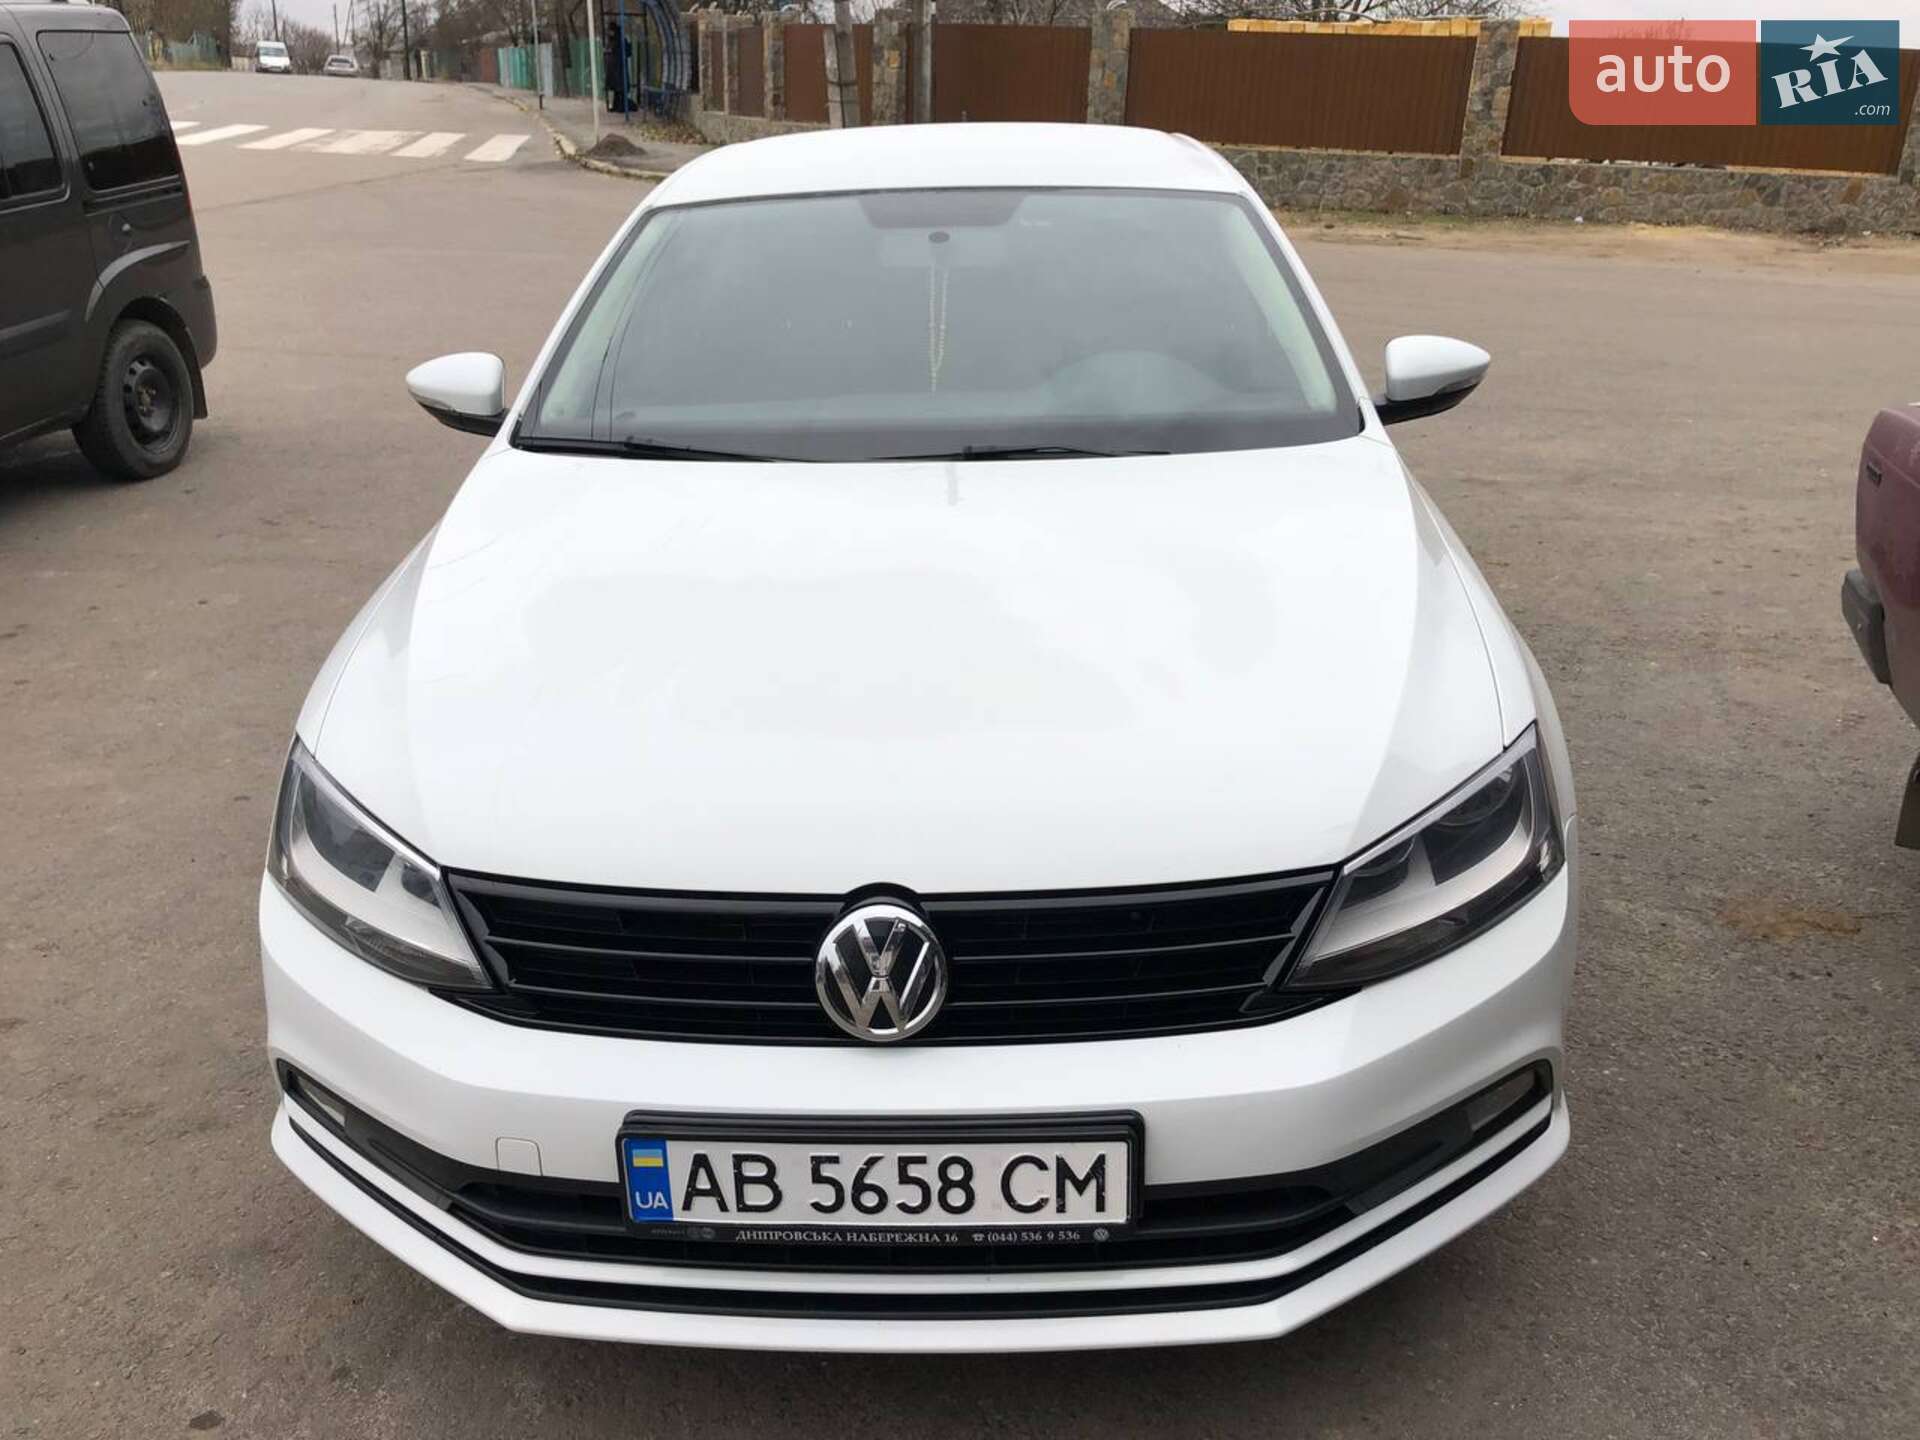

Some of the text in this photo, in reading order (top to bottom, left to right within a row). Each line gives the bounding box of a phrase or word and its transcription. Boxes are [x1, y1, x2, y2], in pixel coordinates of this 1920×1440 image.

[809, 1152, 976, 1215] 5658
[635, 1190, 669, 1211] UA
[846, 1231, 940, 1244] НАБЕРЕЖНА
[944, 1233, 959, 1243] 16
[987, 1231, 1018, 1243] (044)
[1021, 1231, 1043, 1242] 536
[1058, 1230, 1081, 1241] 536
